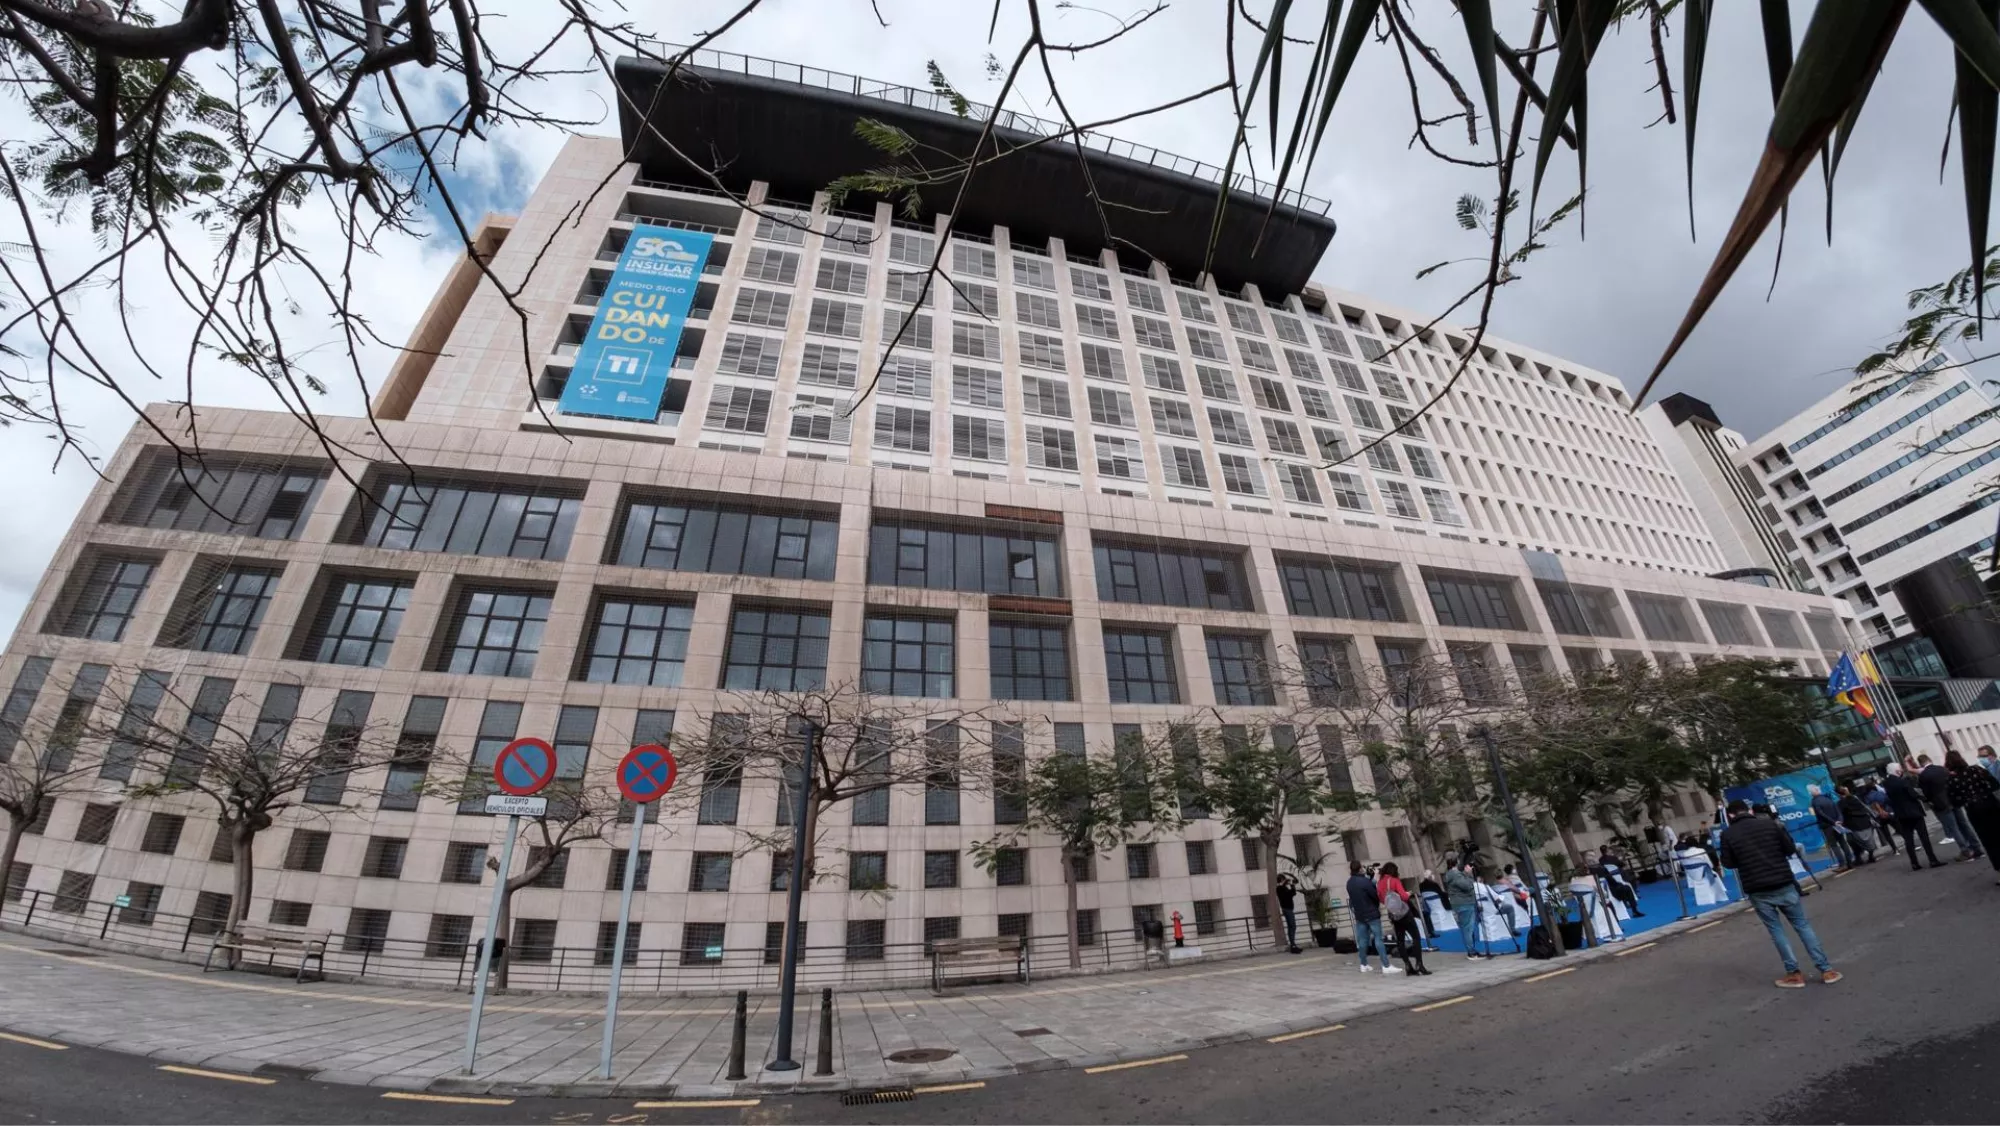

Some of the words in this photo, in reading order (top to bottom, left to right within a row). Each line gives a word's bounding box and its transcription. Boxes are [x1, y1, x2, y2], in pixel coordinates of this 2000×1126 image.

[626, 260, 693, 275] INSULAR
[619, 281, 653, 290] MEDIO
[656, 285, 686, 294] SICLO
[612, 291, 666, 310] CUI
[605, 307, 671, 329] DAN
[597, 323, 647, 344] DO
[648, 336, 666, 345] DE
[608, 355, 639, 375] TI
[504, 797, 529, 805] EXCEPTO
[516, 806, 544, 814] OFICIALES
[1778, 811, 1803, 821] ANDO
